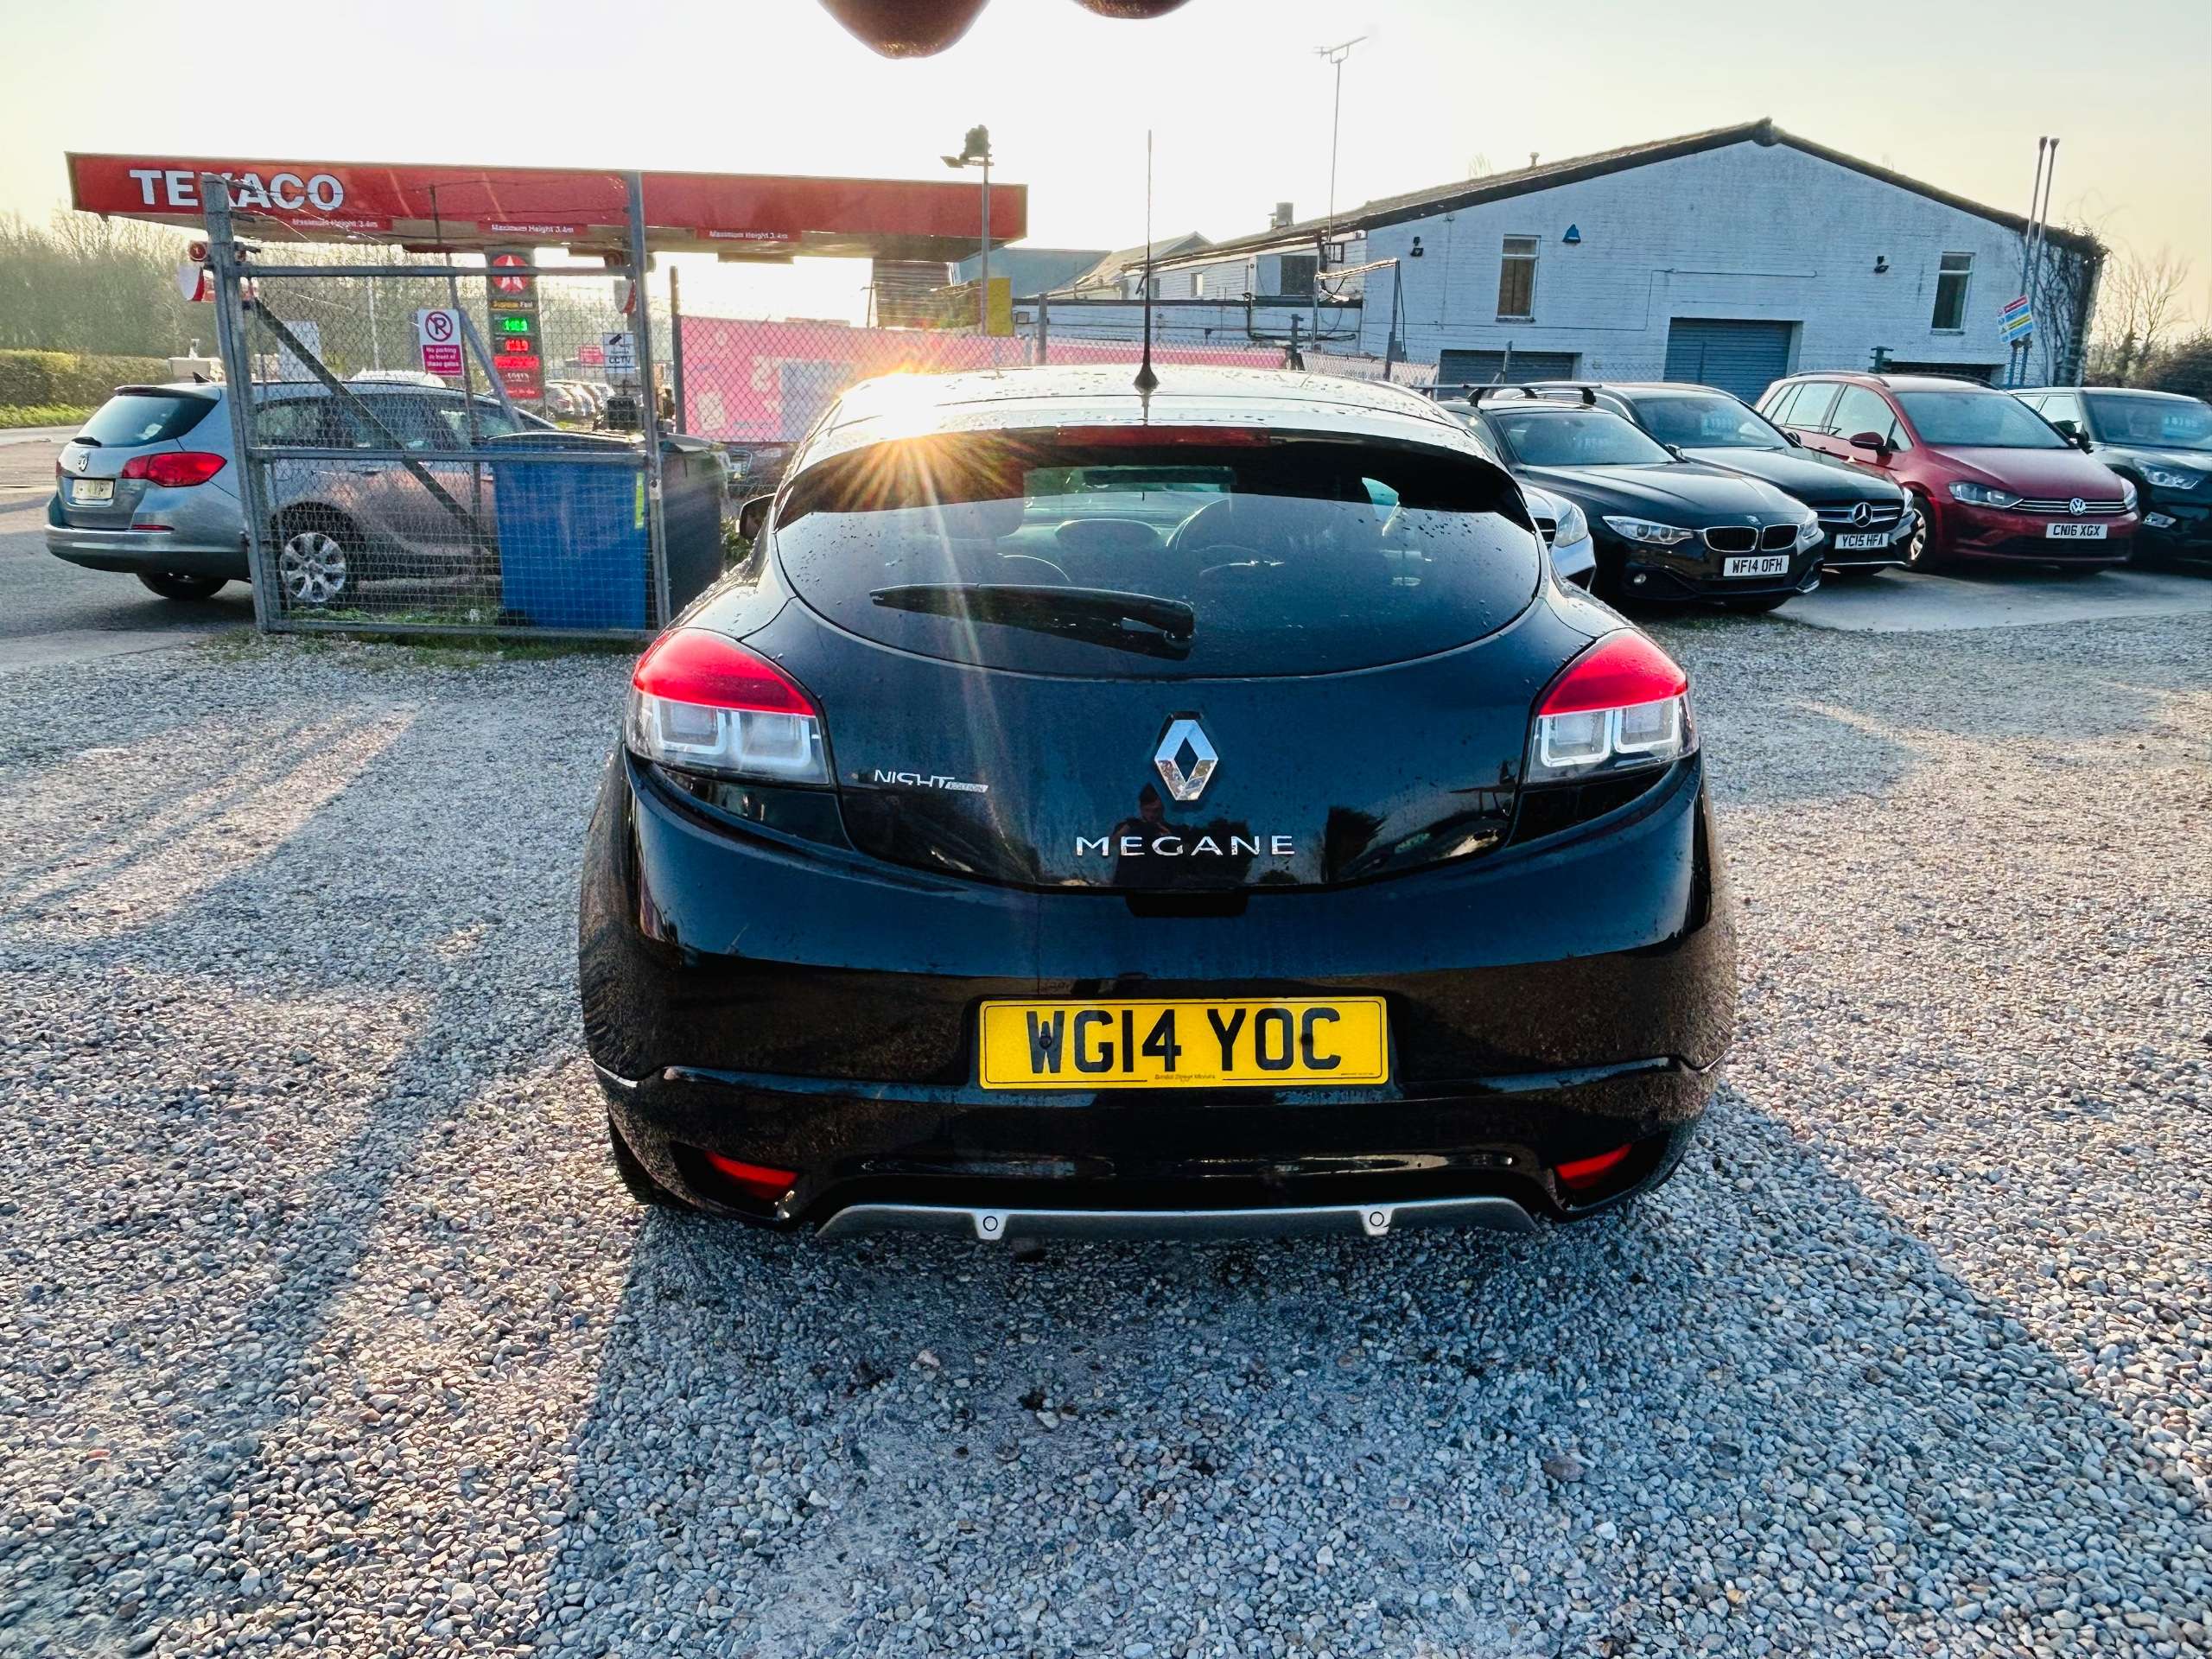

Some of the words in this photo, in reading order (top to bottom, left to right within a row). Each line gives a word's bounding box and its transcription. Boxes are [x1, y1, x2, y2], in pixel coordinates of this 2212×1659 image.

[528, 225, 554, 233] Height
[2053, 524, 2077, 536] CN16
[2080, 524, 2101, 537] XGX
[1841, 534, 1865, 547] YC15
[1732, 558, 1758, 574] WF14
[1761, 557, 1783, 572] OFH
[874, 769, 955, 788] NIGHT
[1076, 835, 1295, 856] MEGANE
[1026, 1008, 1182, 1074] WG14
[1206, 1007, 1342, 1072] YOC
